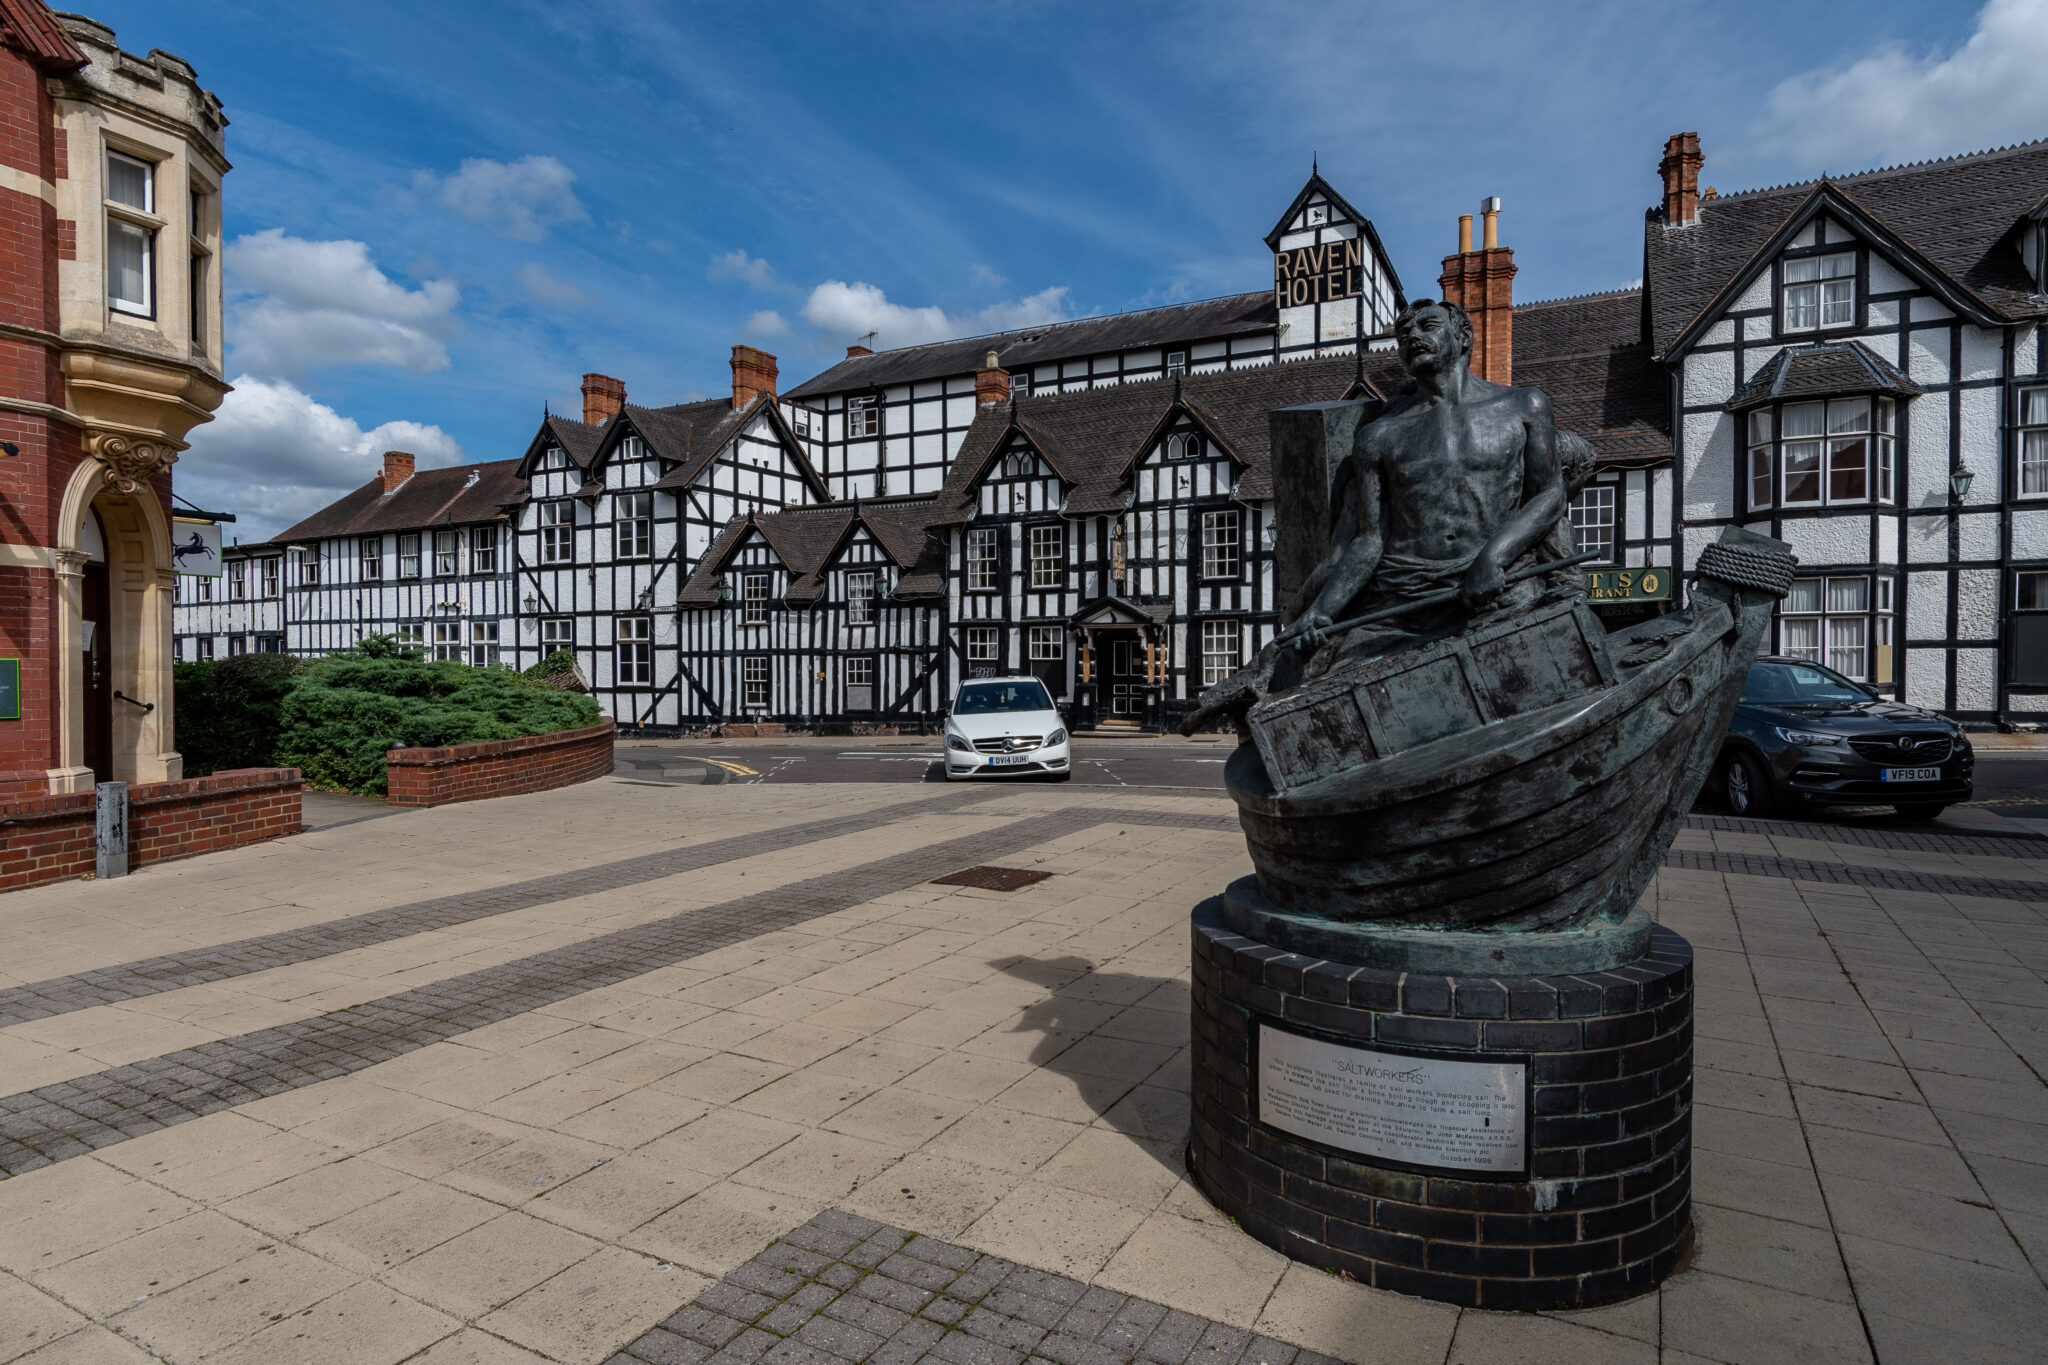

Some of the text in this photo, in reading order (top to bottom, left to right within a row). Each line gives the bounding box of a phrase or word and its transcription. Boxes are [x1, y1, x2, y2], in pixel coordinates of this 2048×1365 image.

[1275, 238, 1362, 281] RAVEN
[1276, 269, 1362, 309] HOTEL
[1891, 769, 1915, 780] VF19
[1287, 1063, 1312, 1074] sculpture
[1315, 1070, 1346, 1082] illustrates
[1356, 1079, 1376, 1089] family
[1437, 1092, 1472, 1101] producing
[1289, 1078, 1310, 1087] wooden
[1312, 1083, 1322, 1091] tub
[1324, 1088, 1340, 1096] used
[1354, 1093, 1381, 1104] draining
[1399, 1101, 1416, 1110] brine
[1292, 1071, 1313, 1082] drawing
[1343, 1084, 1357, 1092] from
[1368, 1089, 1385, 1097] brine
[1388, 1092, 1412, 1102] boiling
[1415, 1096, 1438, 1106] trough
[1458, 1102, 1491, 1110] scooping
[1311, 1106, 1331, 1116] Council
[1326, 1104, 1347, 1113] Council
[1350, 1110, 1377, 1120] gratefully
[1380, 1116, 1424, 1127] acknowledges
[1440, 1124, 1468, 1132] financial
[1304, 1112, 1327, 1122] heritage
[1329, 1119, 1355, 1129] sculpture
[1384, 1130, 1424, 1141] considerable
[1426, 1137, 1456, 1145] technical
[1307, 1119, 1322, 1127] Water
[1336, 1127, 1356, 1136] Capital
[1415, 1142, 1442, 1151] Midlands
[1445, 1146, 1477, 1155] Electricity
[1440, 1154, 1472, 1163] October
